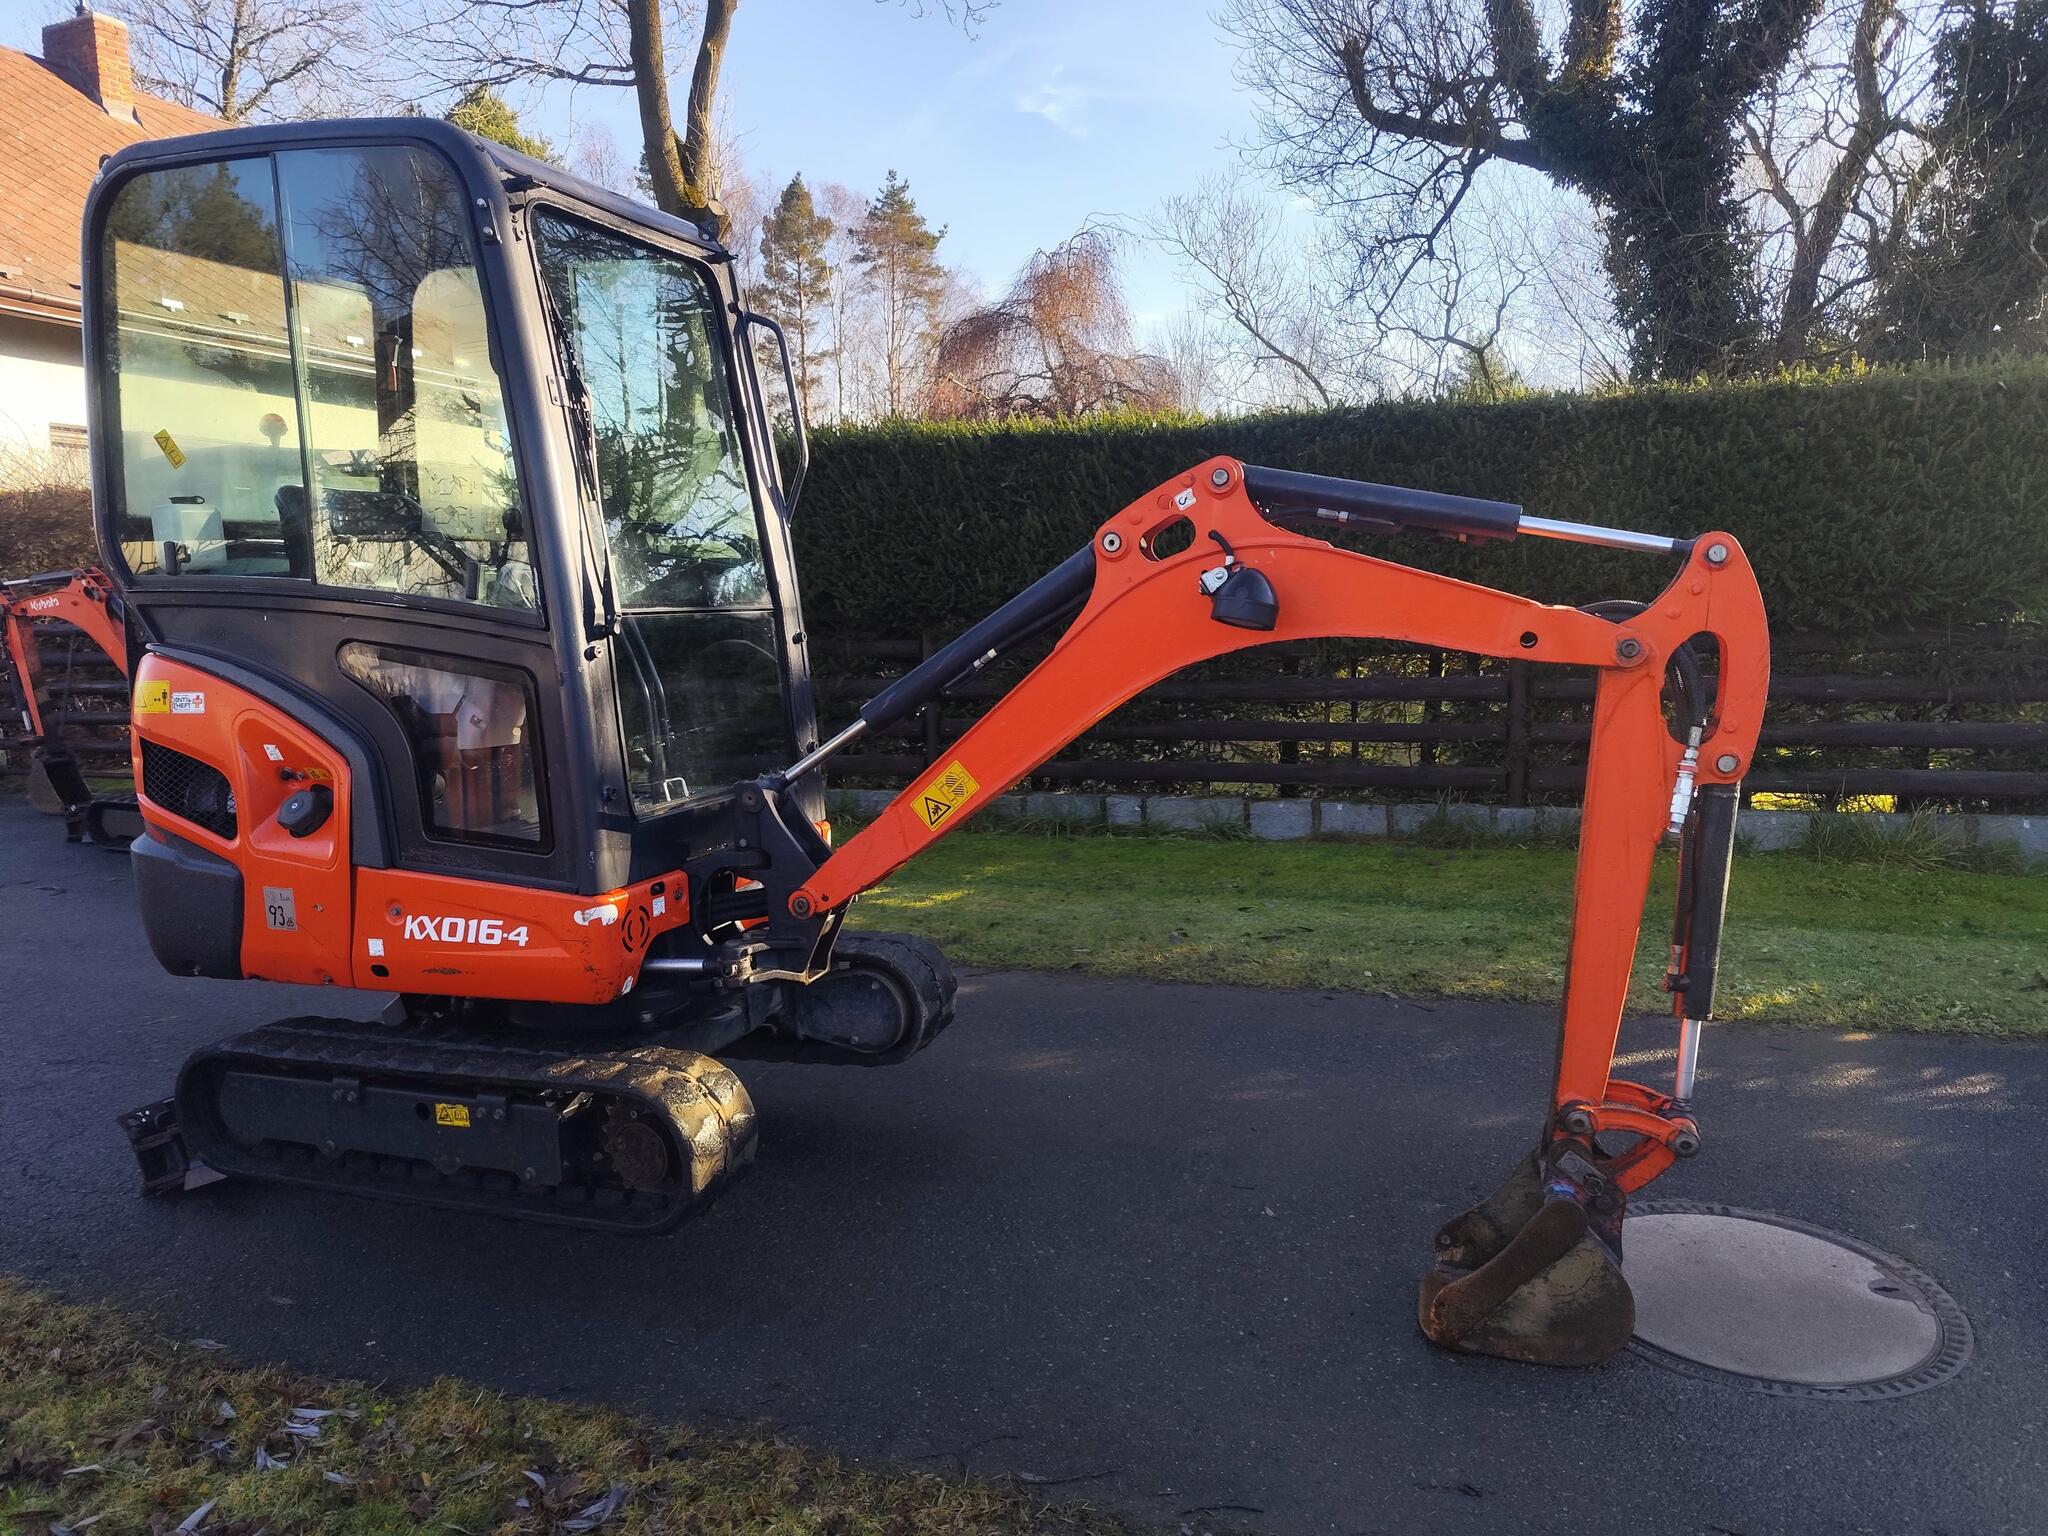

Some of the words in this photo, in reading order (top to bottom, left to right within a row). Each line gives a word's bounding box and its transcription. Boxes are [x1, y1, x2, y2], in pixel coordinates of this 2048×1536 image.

[30, 597, 60, 611] Kubota
[269, 904, 285, 926] 93
[403, 914, 529, 947] KX016-4
